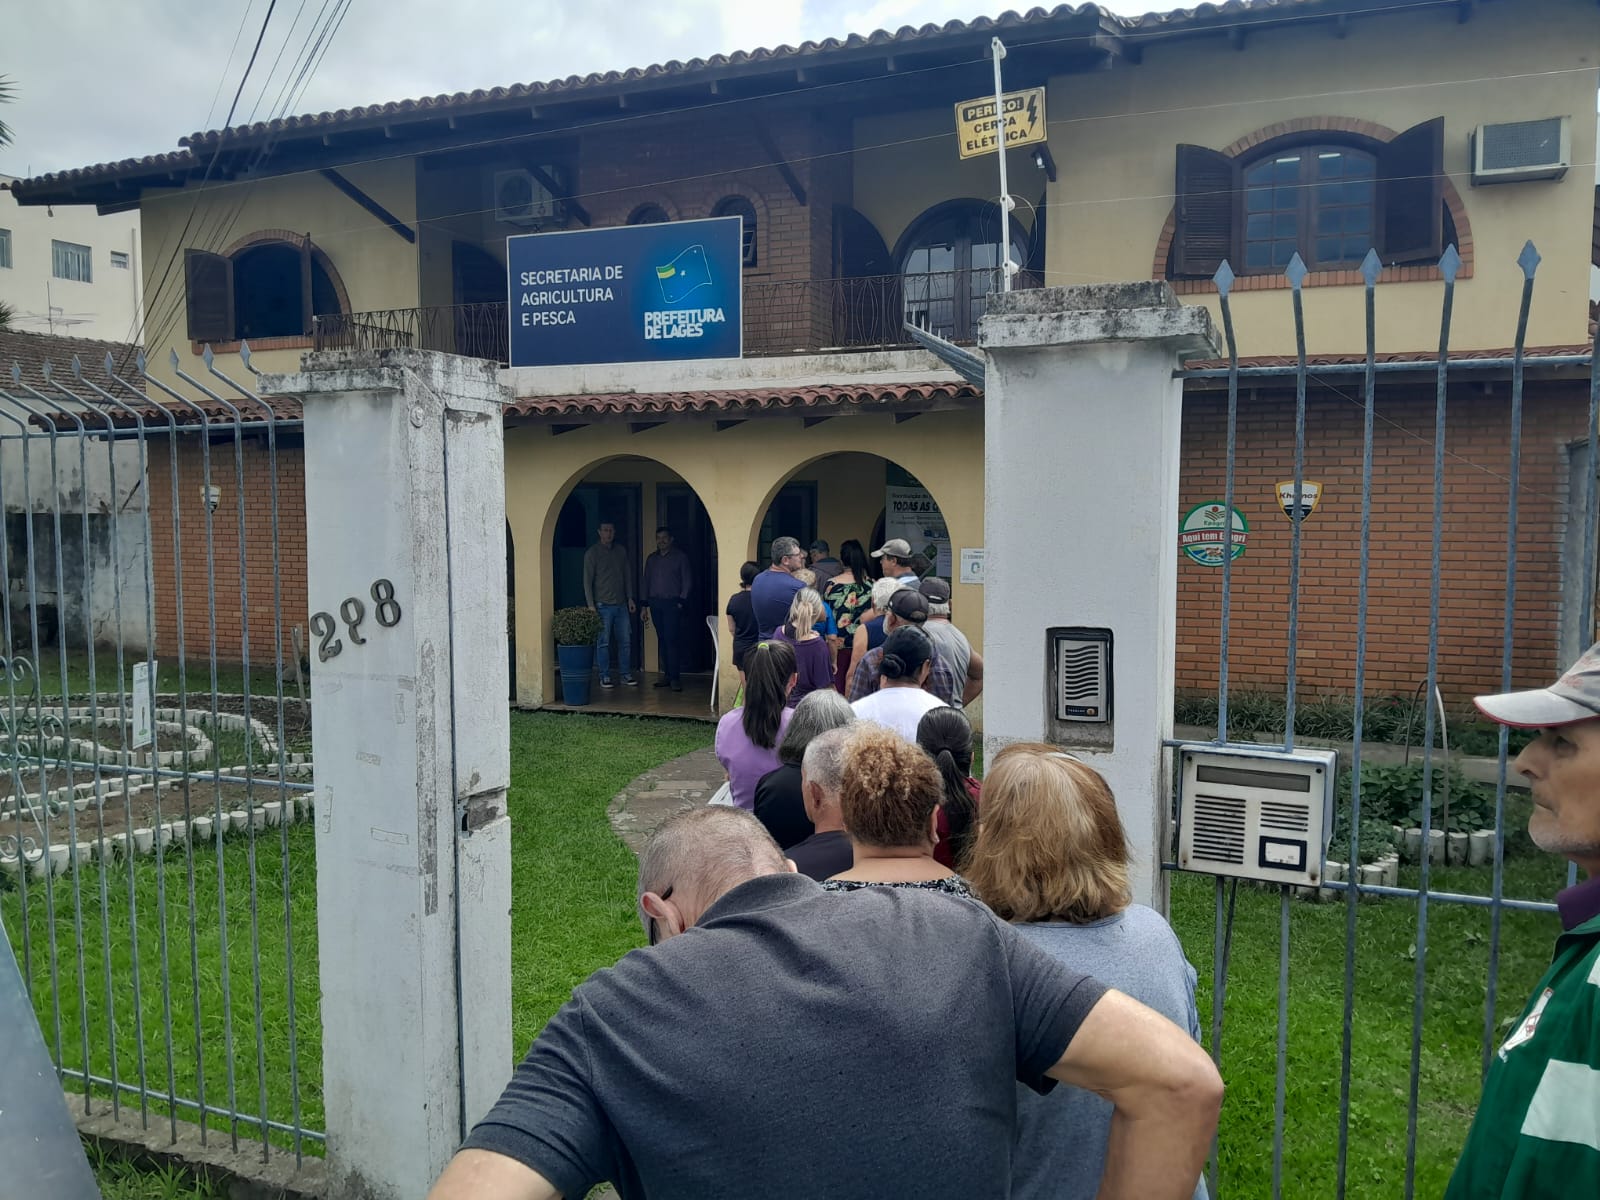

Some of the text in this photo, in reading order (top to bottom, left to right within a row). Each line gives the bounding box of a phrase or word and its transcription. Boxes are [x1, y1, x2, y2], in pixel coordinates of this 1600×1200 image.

[966, 128, 1028, 151] ELÉTICA
[520, 265, 623, 286] SECRETARIA DE
[520, 287, 614, 306] AGRICULTURA
[521, 310, 576, 327] E PESCA
[644, 307, 726, 326] PREFEITURA
[644, 322, 704, 340] DE LAGES
[893, 501, 918, 512] TODAS
[920, 501, 931, 511] AS
[1183, 533, 1201, 543] Aqui
[1219, 532, 1246, 543] Egri
